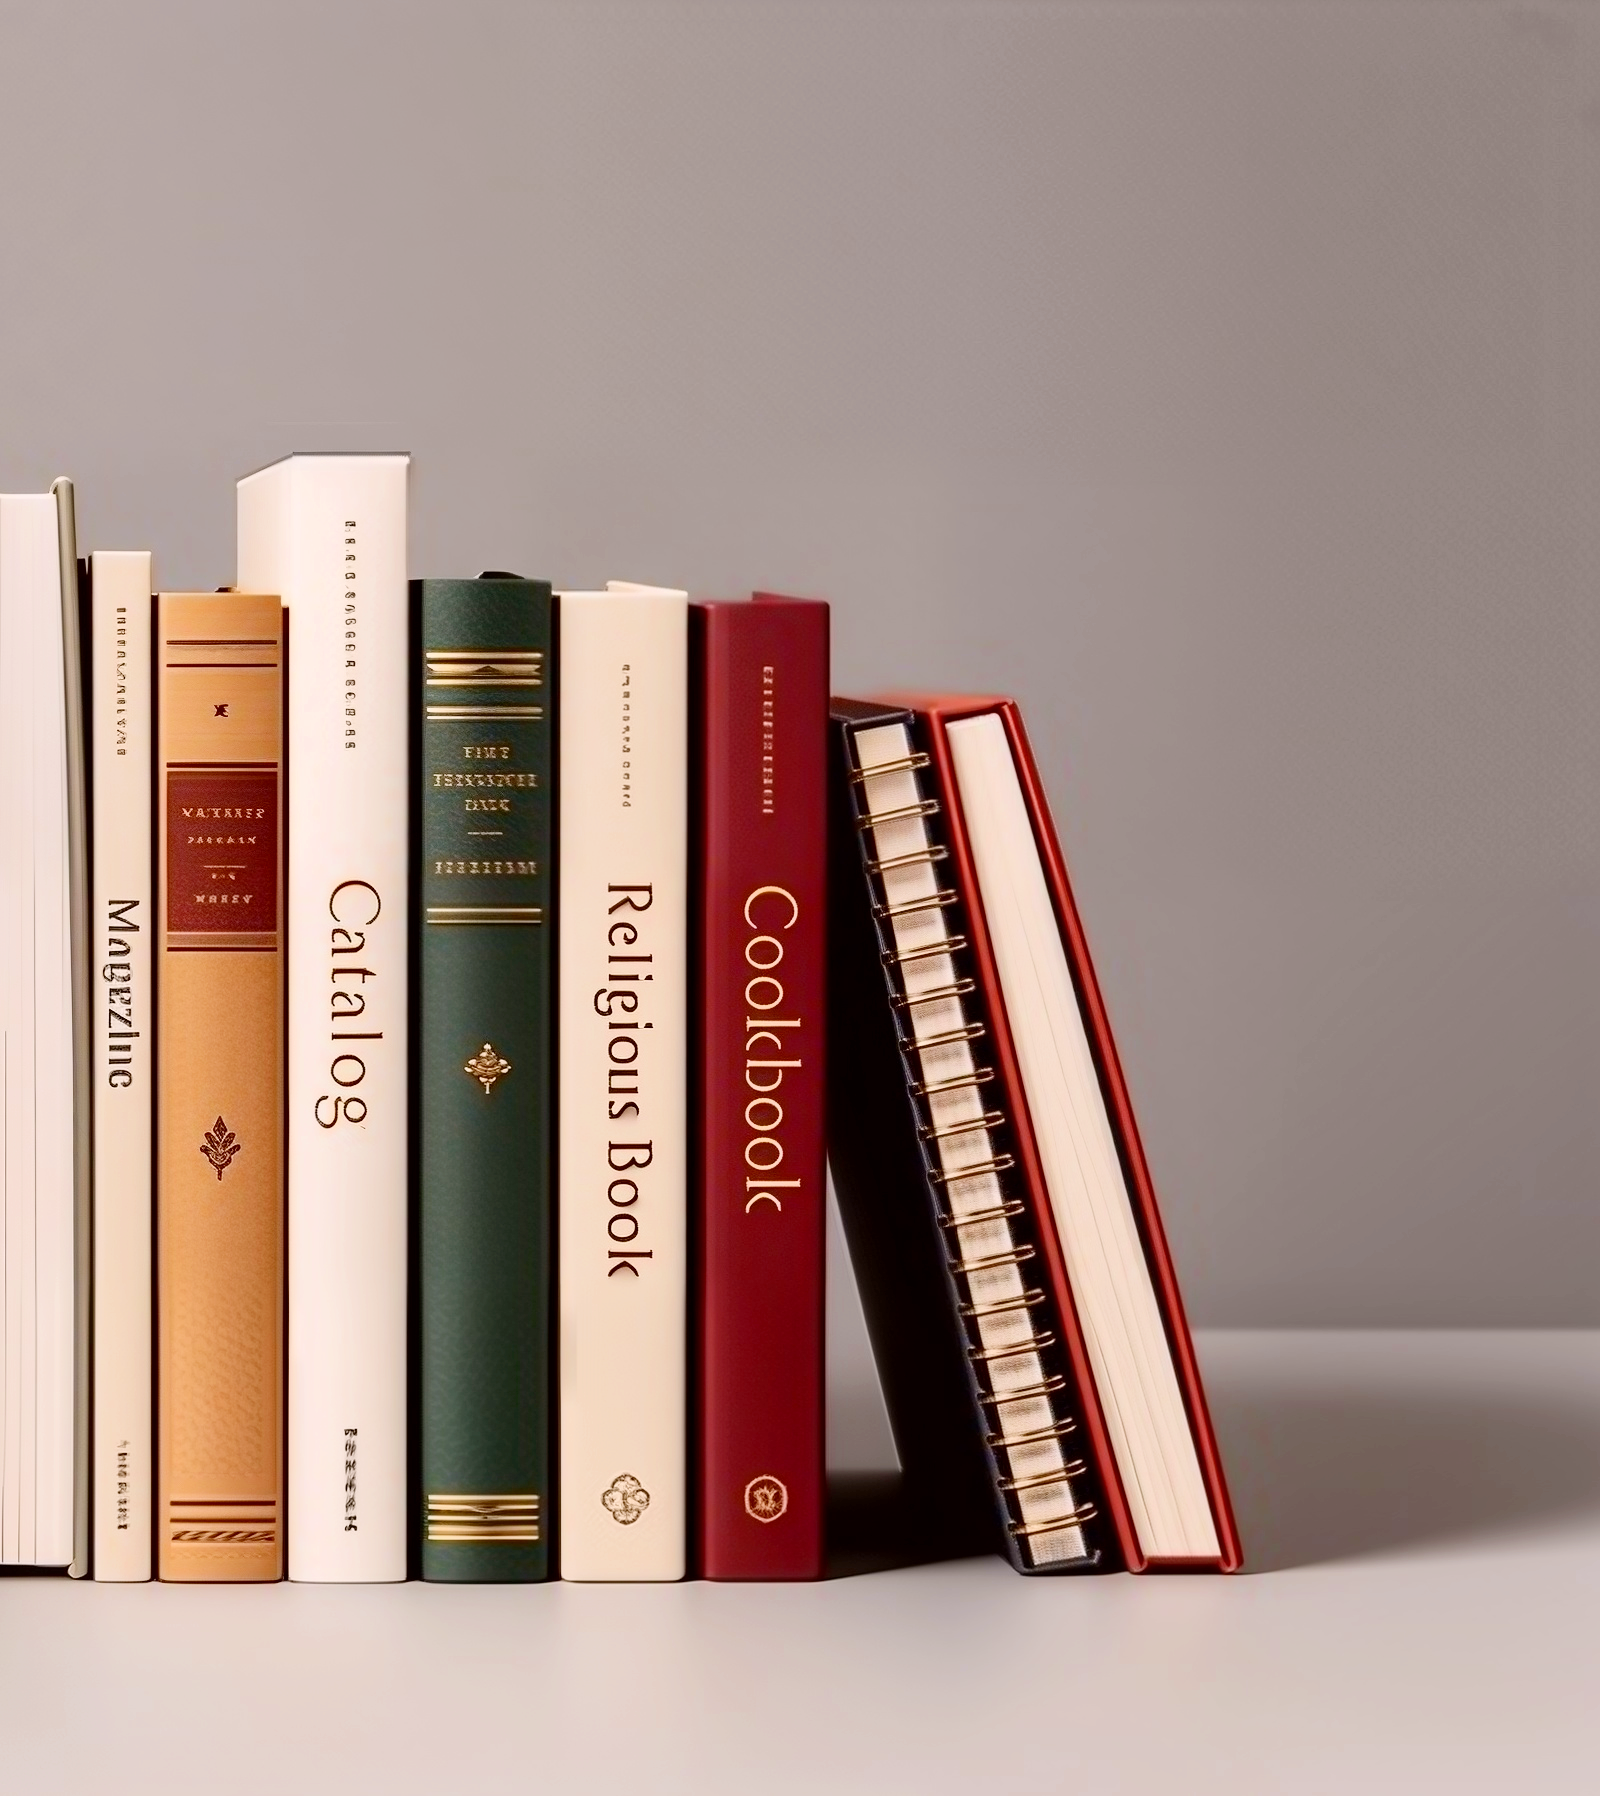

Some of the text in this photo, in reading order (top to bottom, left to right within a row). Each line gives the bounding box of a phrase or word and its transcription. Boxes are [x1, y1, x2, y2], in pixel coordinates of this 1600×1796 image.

[315, 880, 383, 1128] Catalog
[594, 882, 653, 1278] Religious Book
[744, 885, 802, 1214] Cookbook
